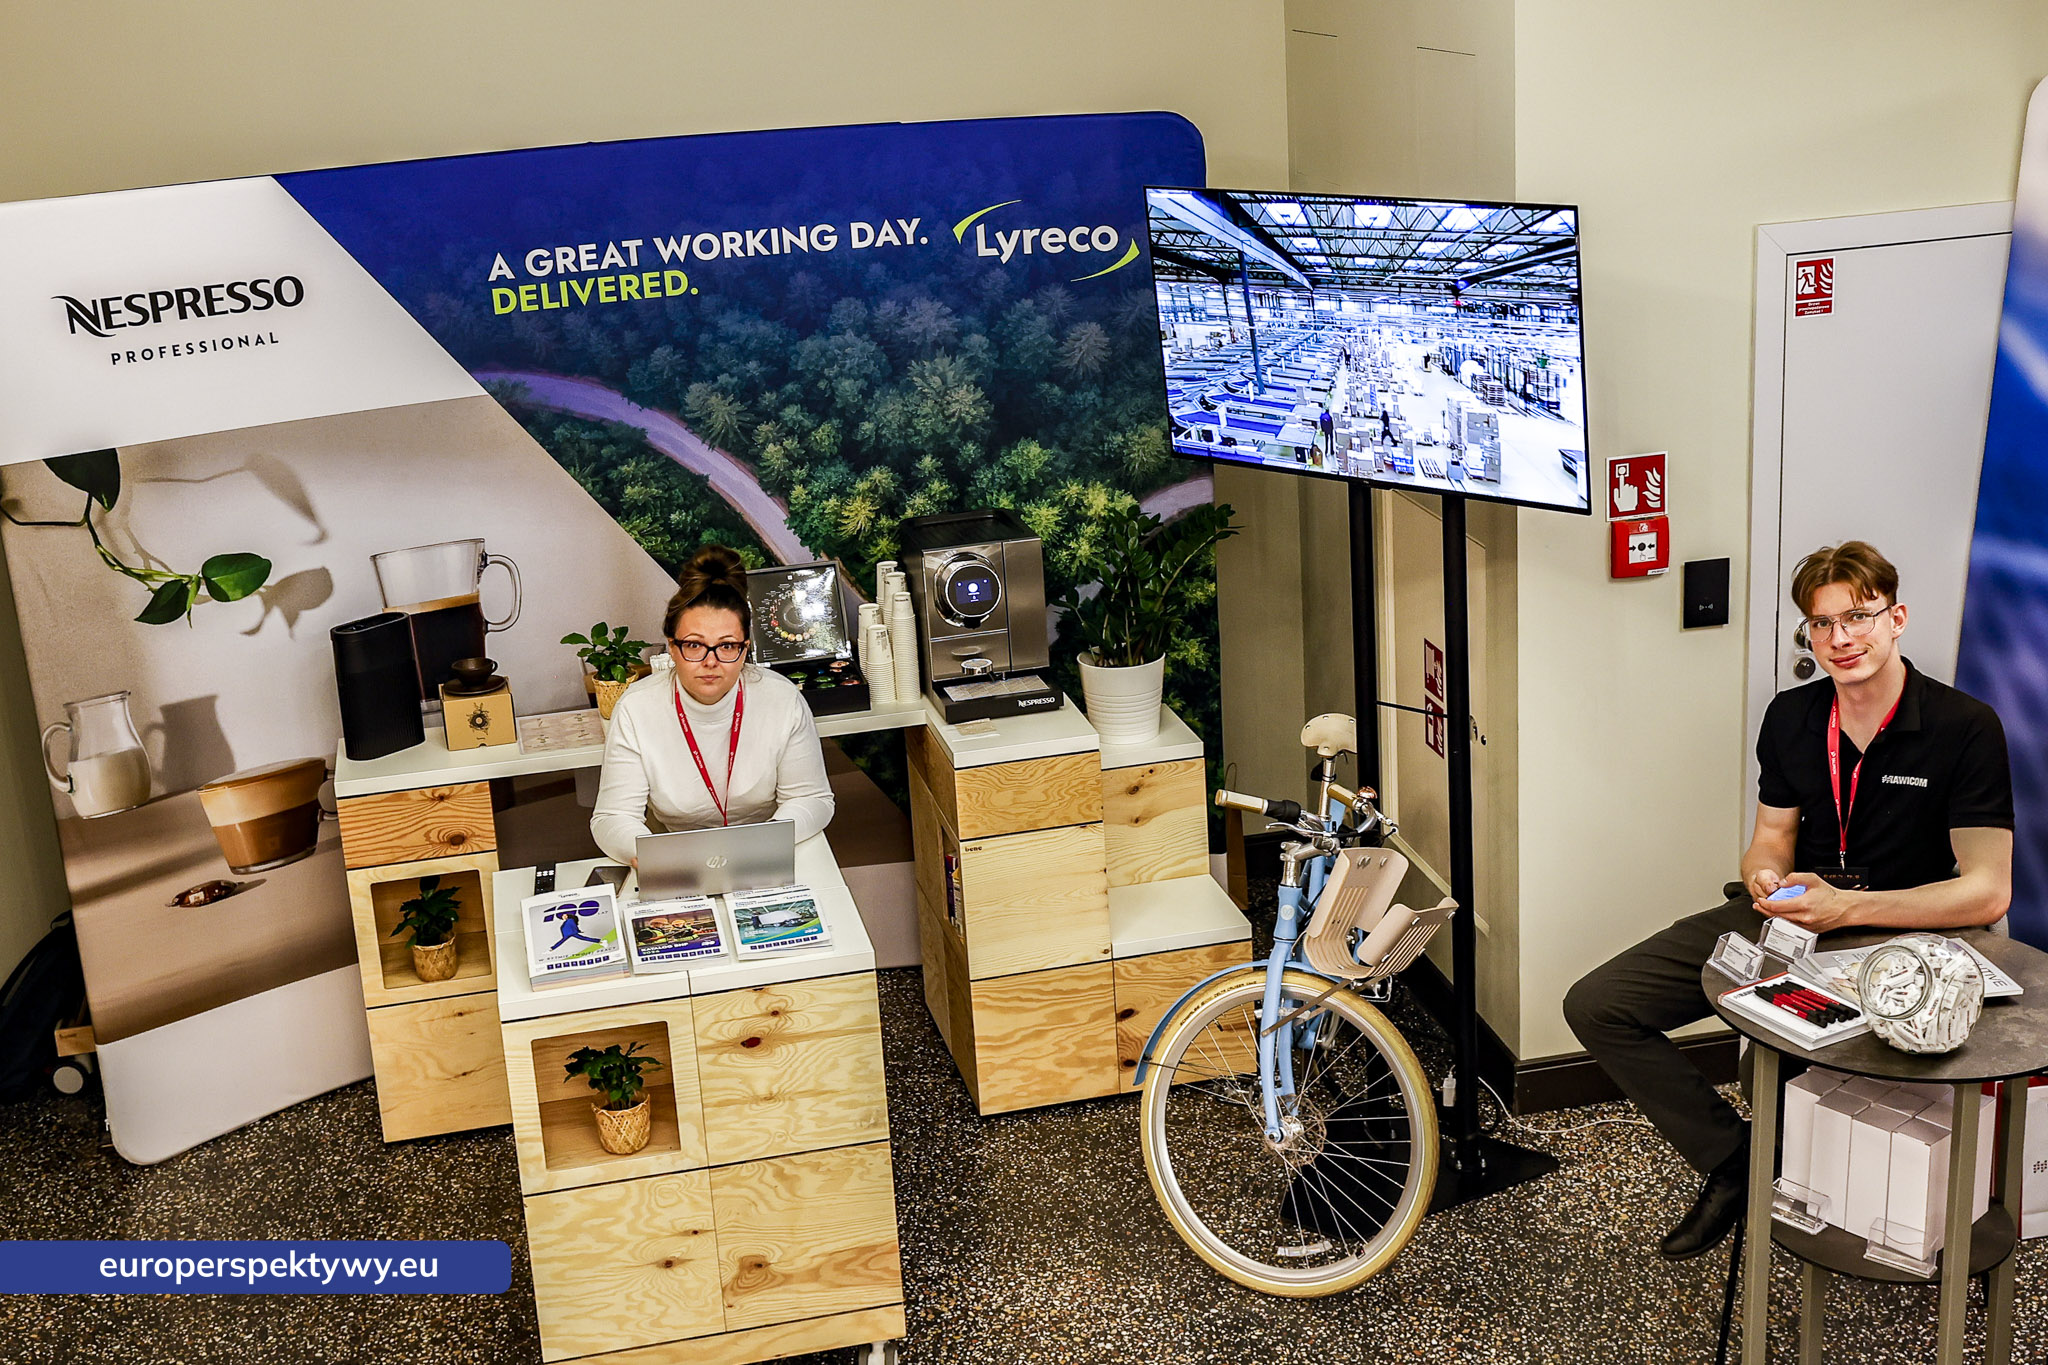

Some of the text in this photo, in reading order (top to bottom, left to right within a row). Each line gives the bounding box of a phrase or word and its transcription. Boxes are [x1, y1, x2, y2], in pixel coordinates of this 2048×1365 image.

[486, 217, 929, 282] A GREAT WORKING DAY.
[975, 221, 1120, 265] Lyreco
[51, 275, 305, 338] NESPRESSO
[491, 268, 700, 316] DELIVERED.
[110, 331, 279, 366] PROFESSIONAL
[1018, 697, 1055, 708] NESPRESSO
